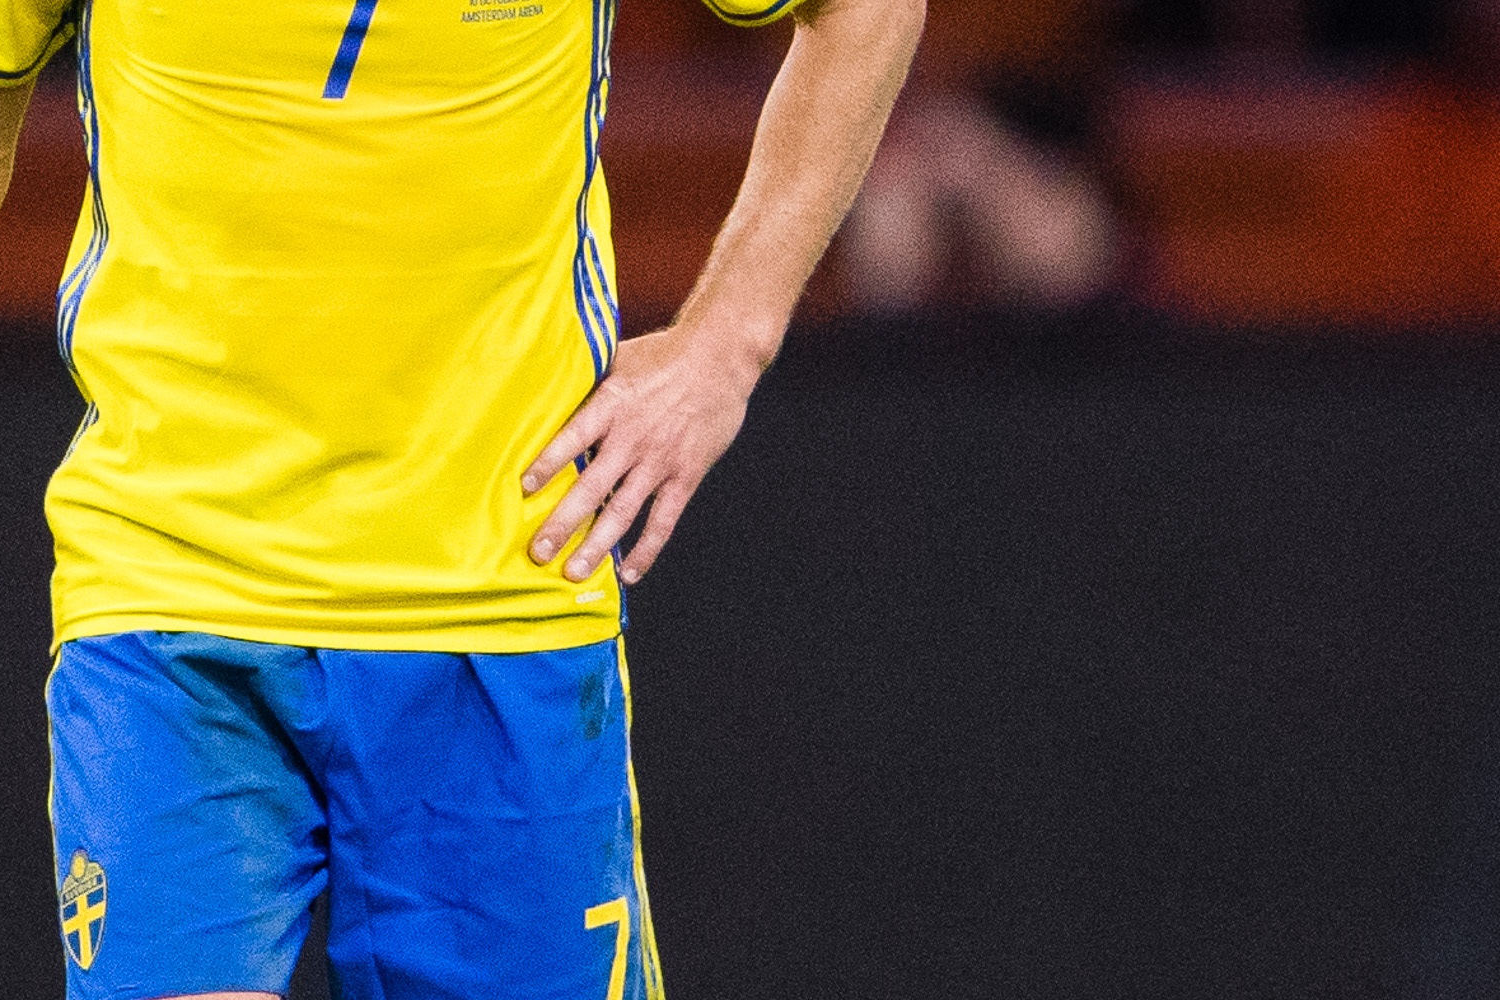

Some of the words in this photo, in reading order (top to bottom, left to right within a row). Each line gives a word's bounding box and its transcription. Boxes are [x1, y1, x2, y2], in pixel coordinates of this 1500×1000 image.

[461, 7, 516, 22] AMSTERDAM
[519, 5, 544, 18] ARENA
[584, 896, 630, 1000] 7
